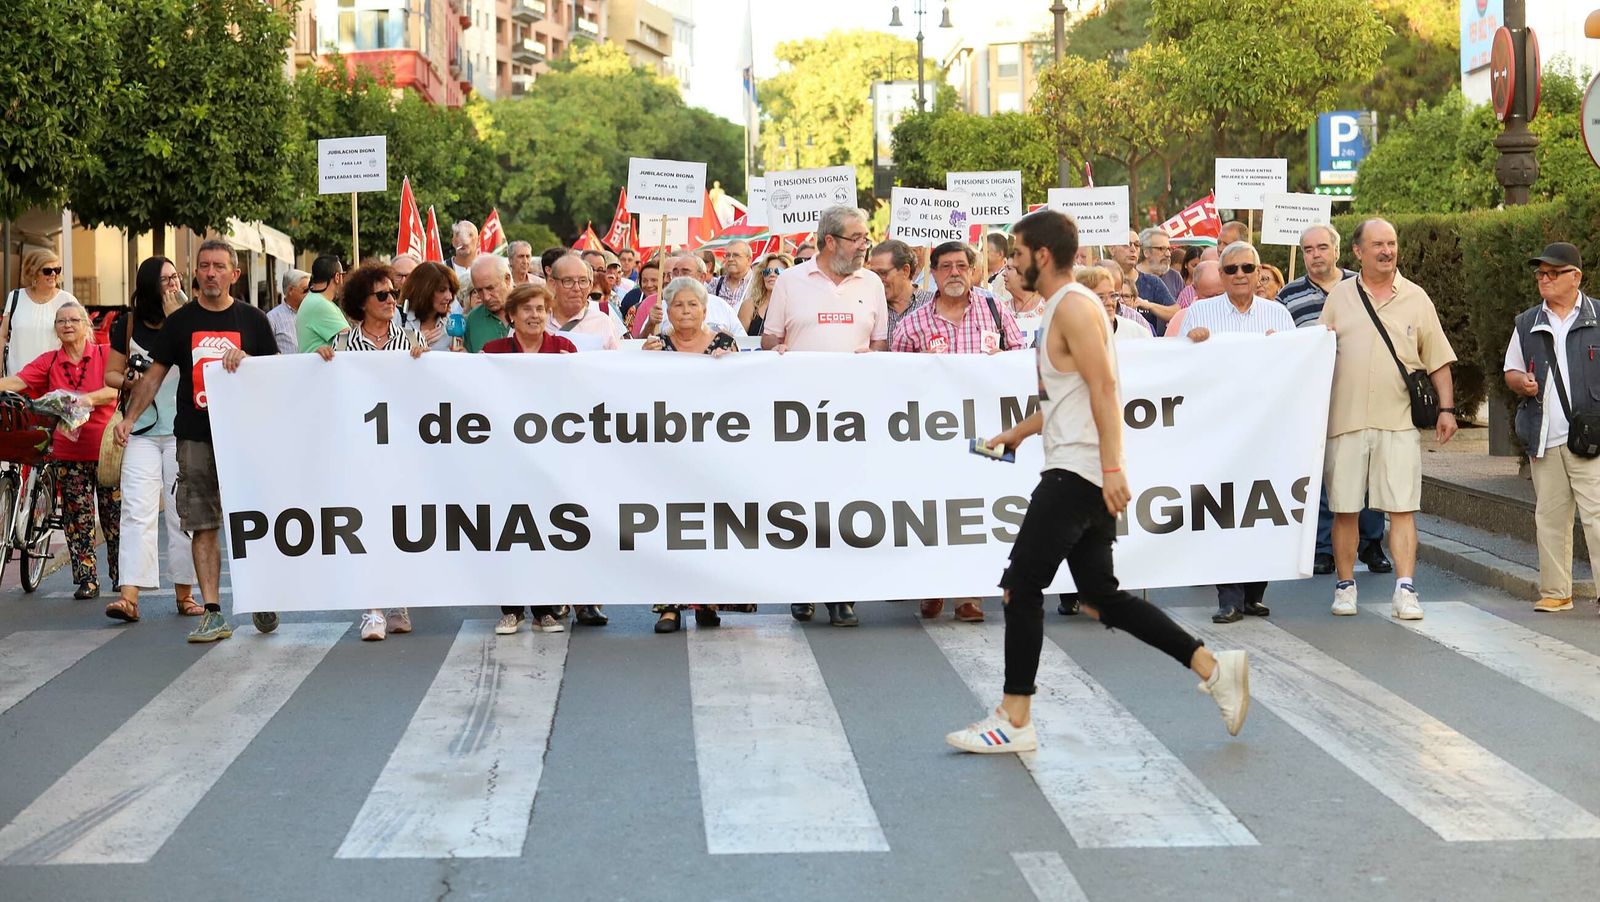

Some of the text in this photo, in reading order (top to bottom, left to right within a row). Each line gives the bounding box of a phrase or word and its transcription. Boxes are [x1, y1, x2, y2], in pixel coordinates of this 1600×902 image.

[1330, 115, 1359, 157] P
[774, 174, 849, 187] PENSIONES DIGNAS
[903, 197, 959, 208] NO AL ROBO
[783, 210, 820, 224] MUJE
[971, 206, 1010, 216] UJERES
[897, 226, 962, 240] PENSIONES
[364, 394, 1184, 444] 1 de octubre Día del Mor
[229, 477, 1310, 559] POR UNAS PENSIONES IGNA
